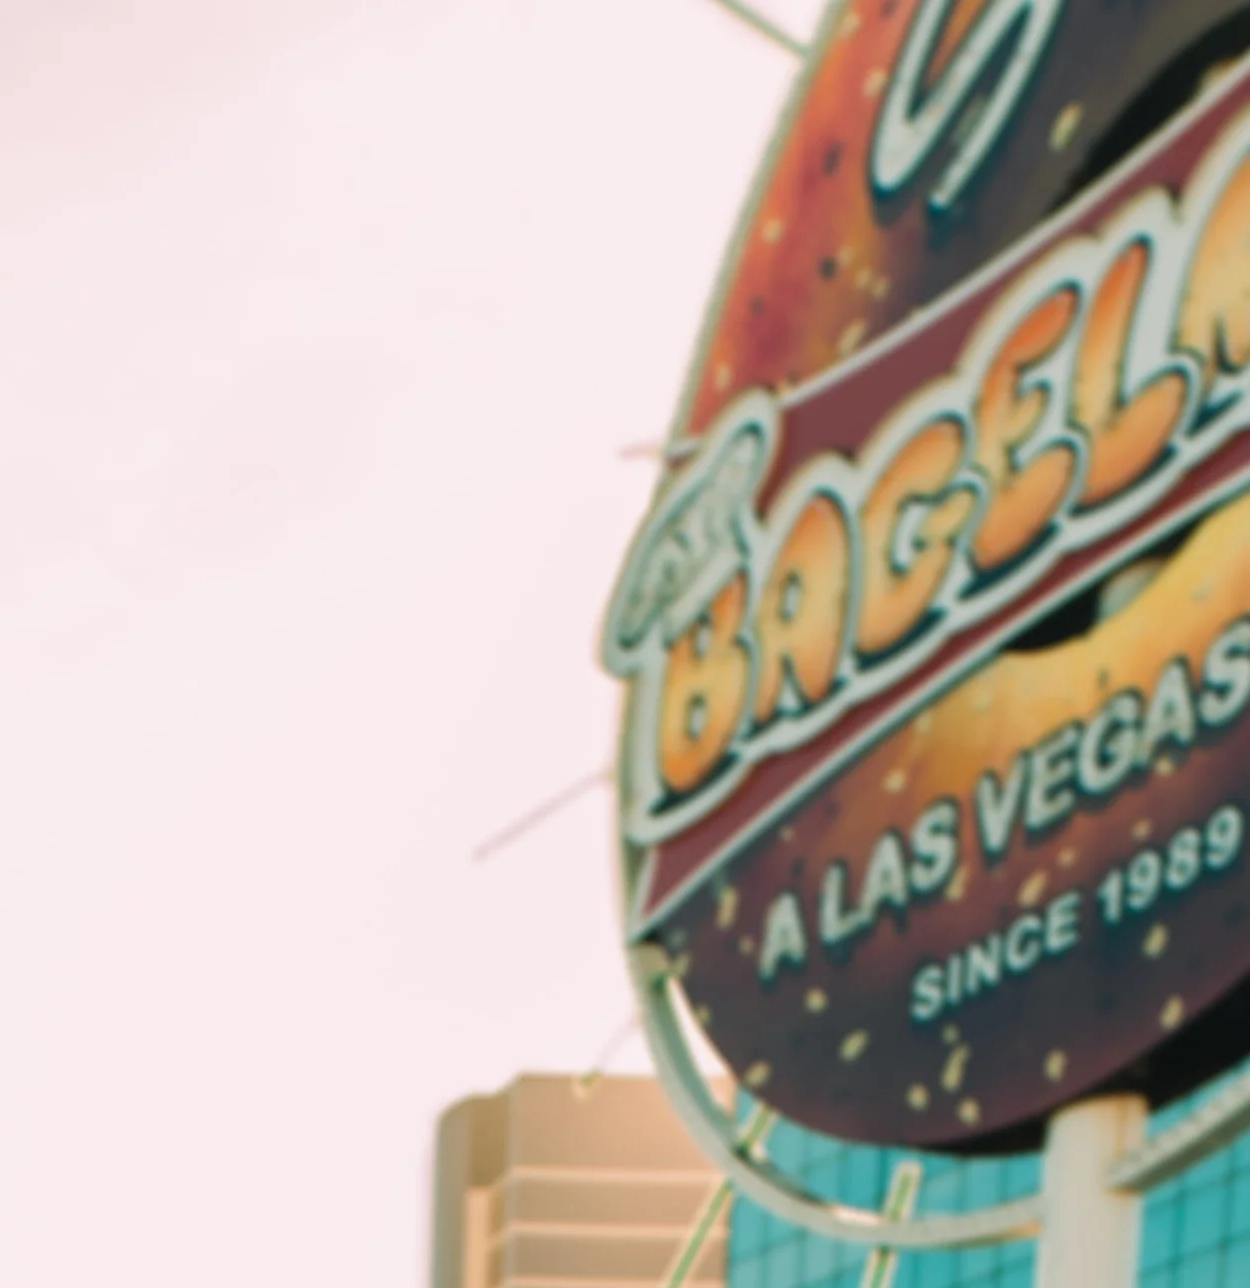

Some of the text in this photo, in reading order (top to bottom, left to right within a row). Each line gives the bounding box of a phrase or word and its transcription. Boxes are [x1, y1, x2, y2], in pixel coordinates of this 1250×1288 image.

[759, 618, 1250, 980] A LAS VEGAS
[910, 805, 1243, 1021] SINCE 1989
